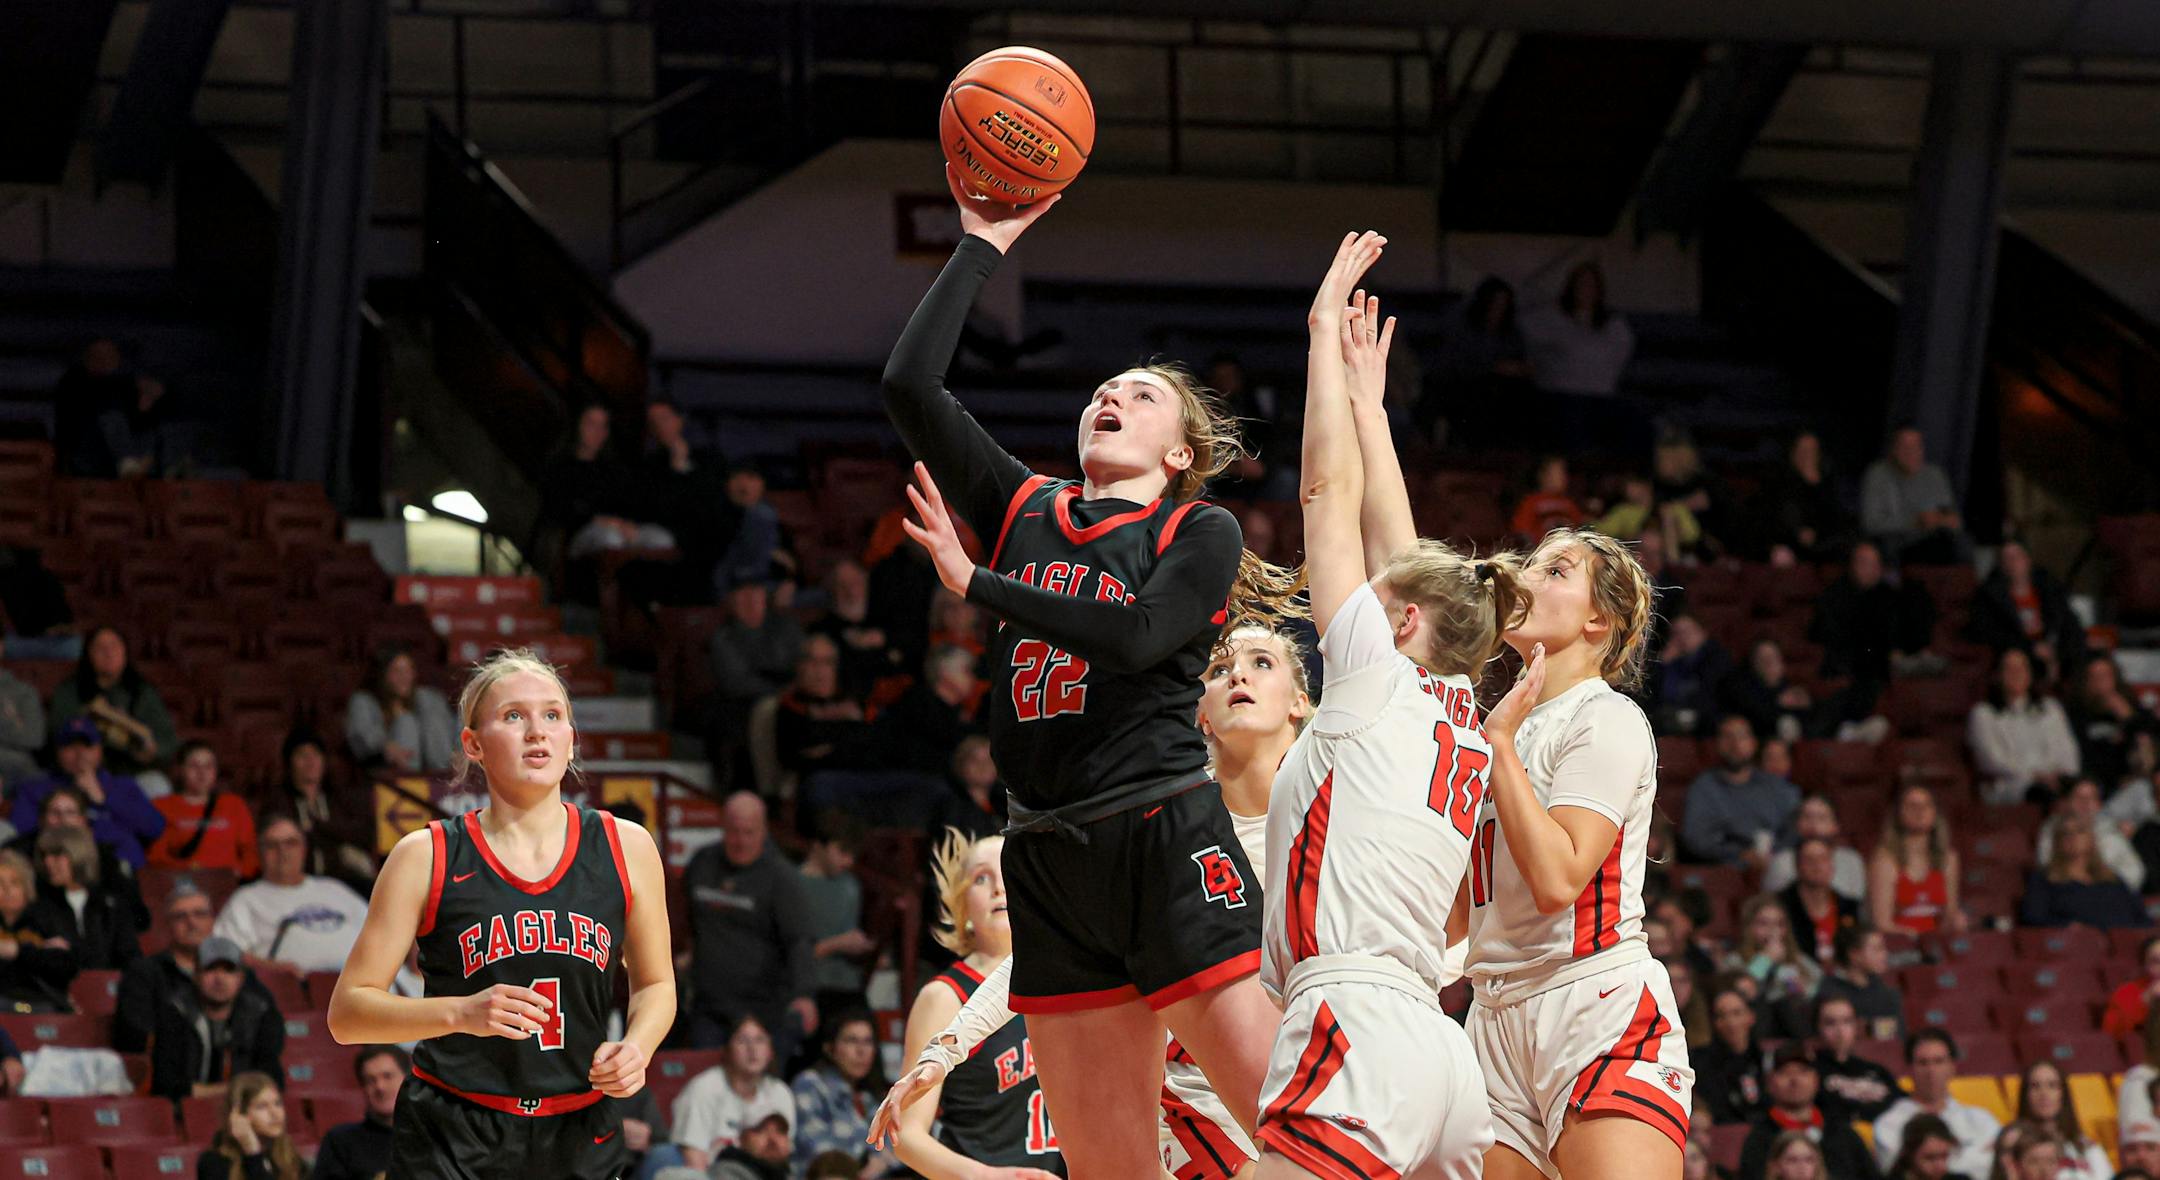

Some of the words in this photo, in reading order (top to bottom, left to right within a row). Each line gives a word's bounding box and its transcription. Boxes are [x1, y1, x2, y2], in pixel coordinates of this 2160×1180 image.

[977, 116, 1059, 173] LEGACY
[1011, 638, 1090, 723] 22
[1427, 720, 1489, 841] 10
[1470, 817, 1496, 908] 11
[458, 910, 612, 979] EAGLES
[528, 977, 565, 1051] 4
